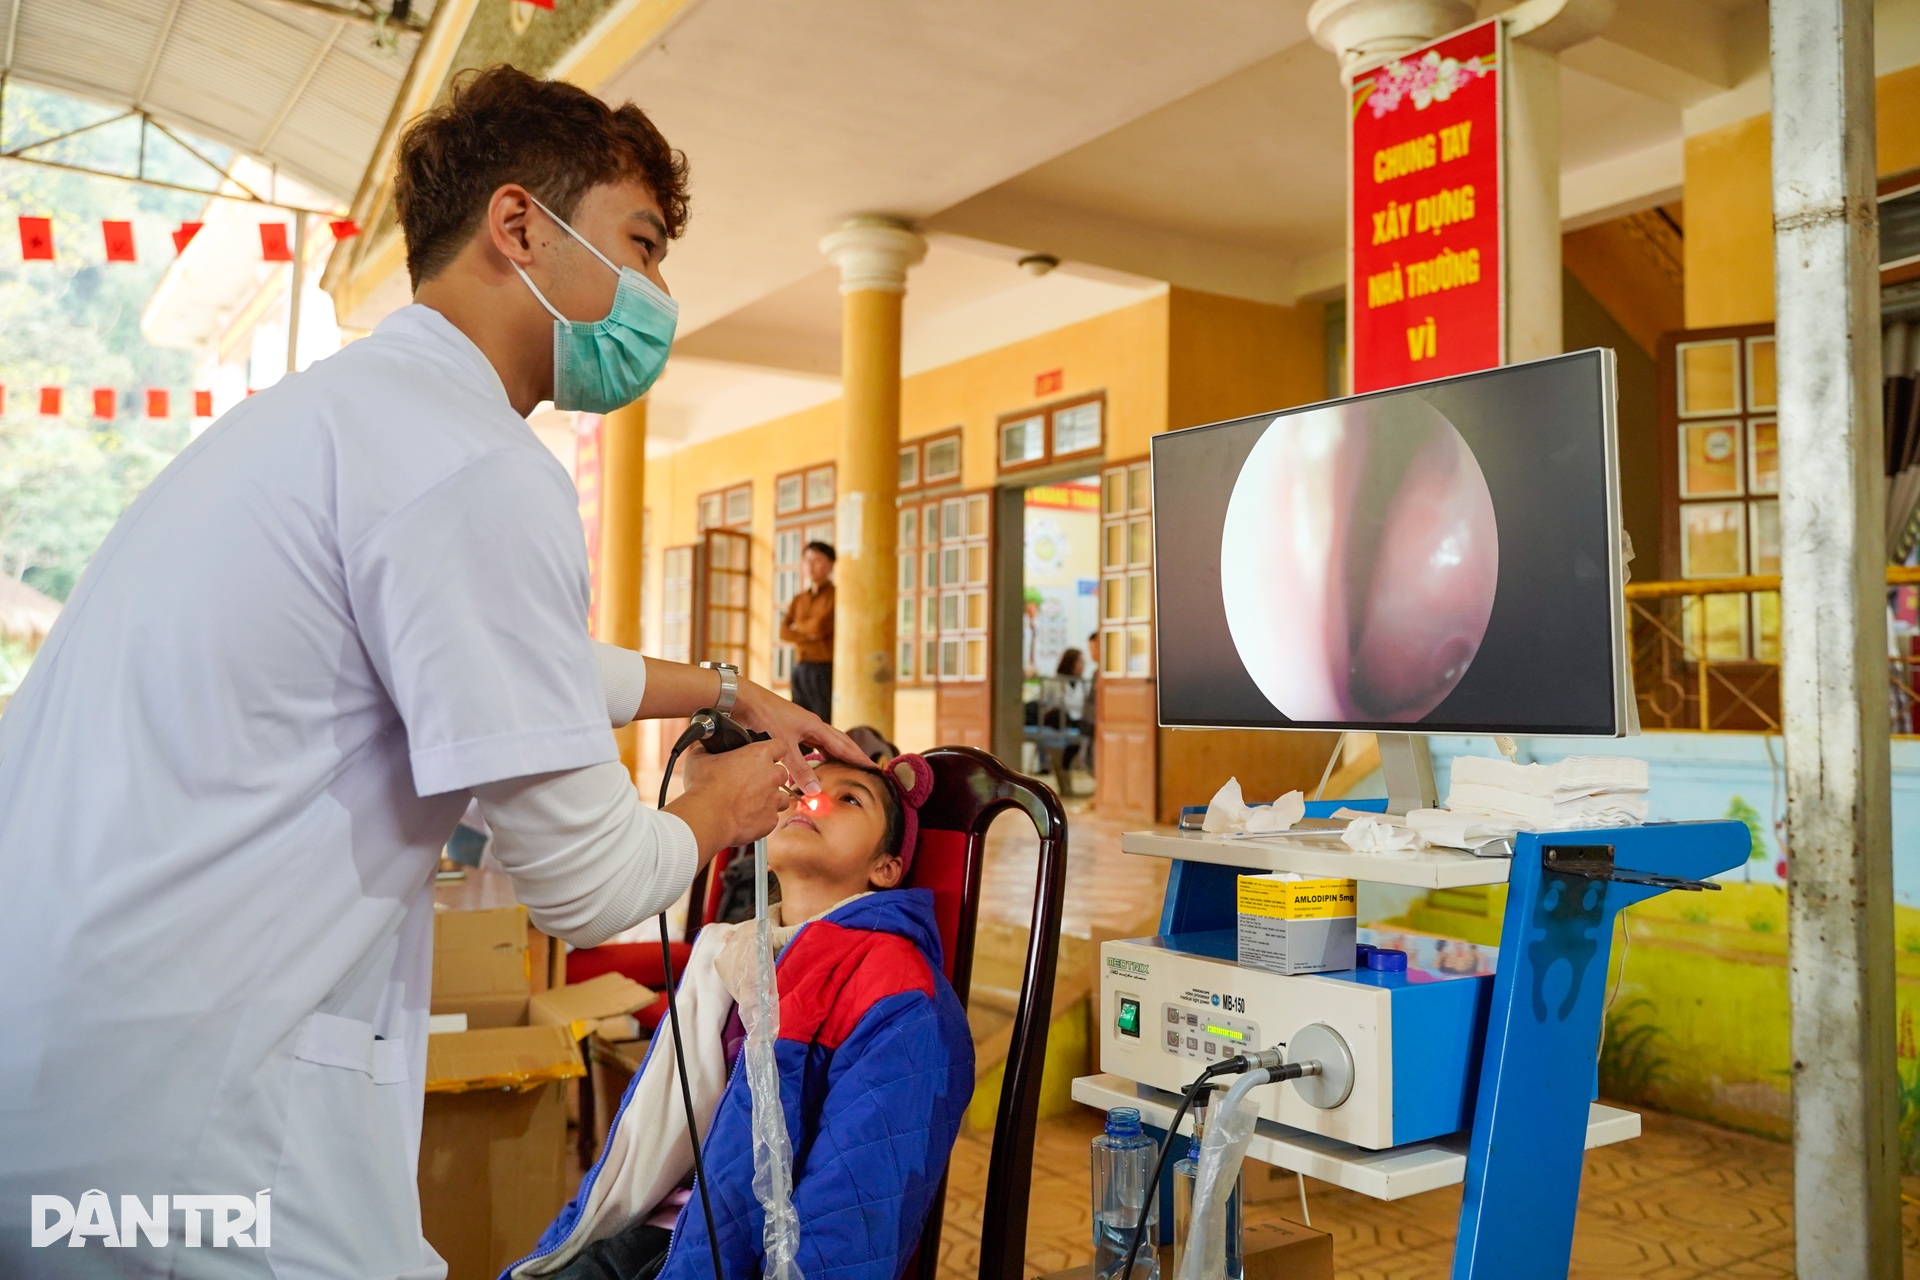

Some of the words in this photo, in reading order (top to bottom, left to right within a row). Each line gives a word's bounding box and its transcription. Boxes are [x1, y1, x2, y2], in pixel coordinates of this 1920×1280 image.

[1374, 132, 1437, 184] CHUNG
[1439, 120, 1473, 163] TAY
[1371, 200, 1412, 247] XÂY
[1415, 184, 1476, 236] DỰNG
[1367, 261, 1404, 309] NHÀ
[1406, 246, 1481, 298] TRƯỜNG
[1406, 316, 1437, 362] VÌ
[1294, 894, 1337, 904] AMLODIPIN
[1339, 893, 1355, 903] 5mg
[1106, 956, 1150, 975] MEDTRIX
[1222, 994, 1245, 1014] MB-150
